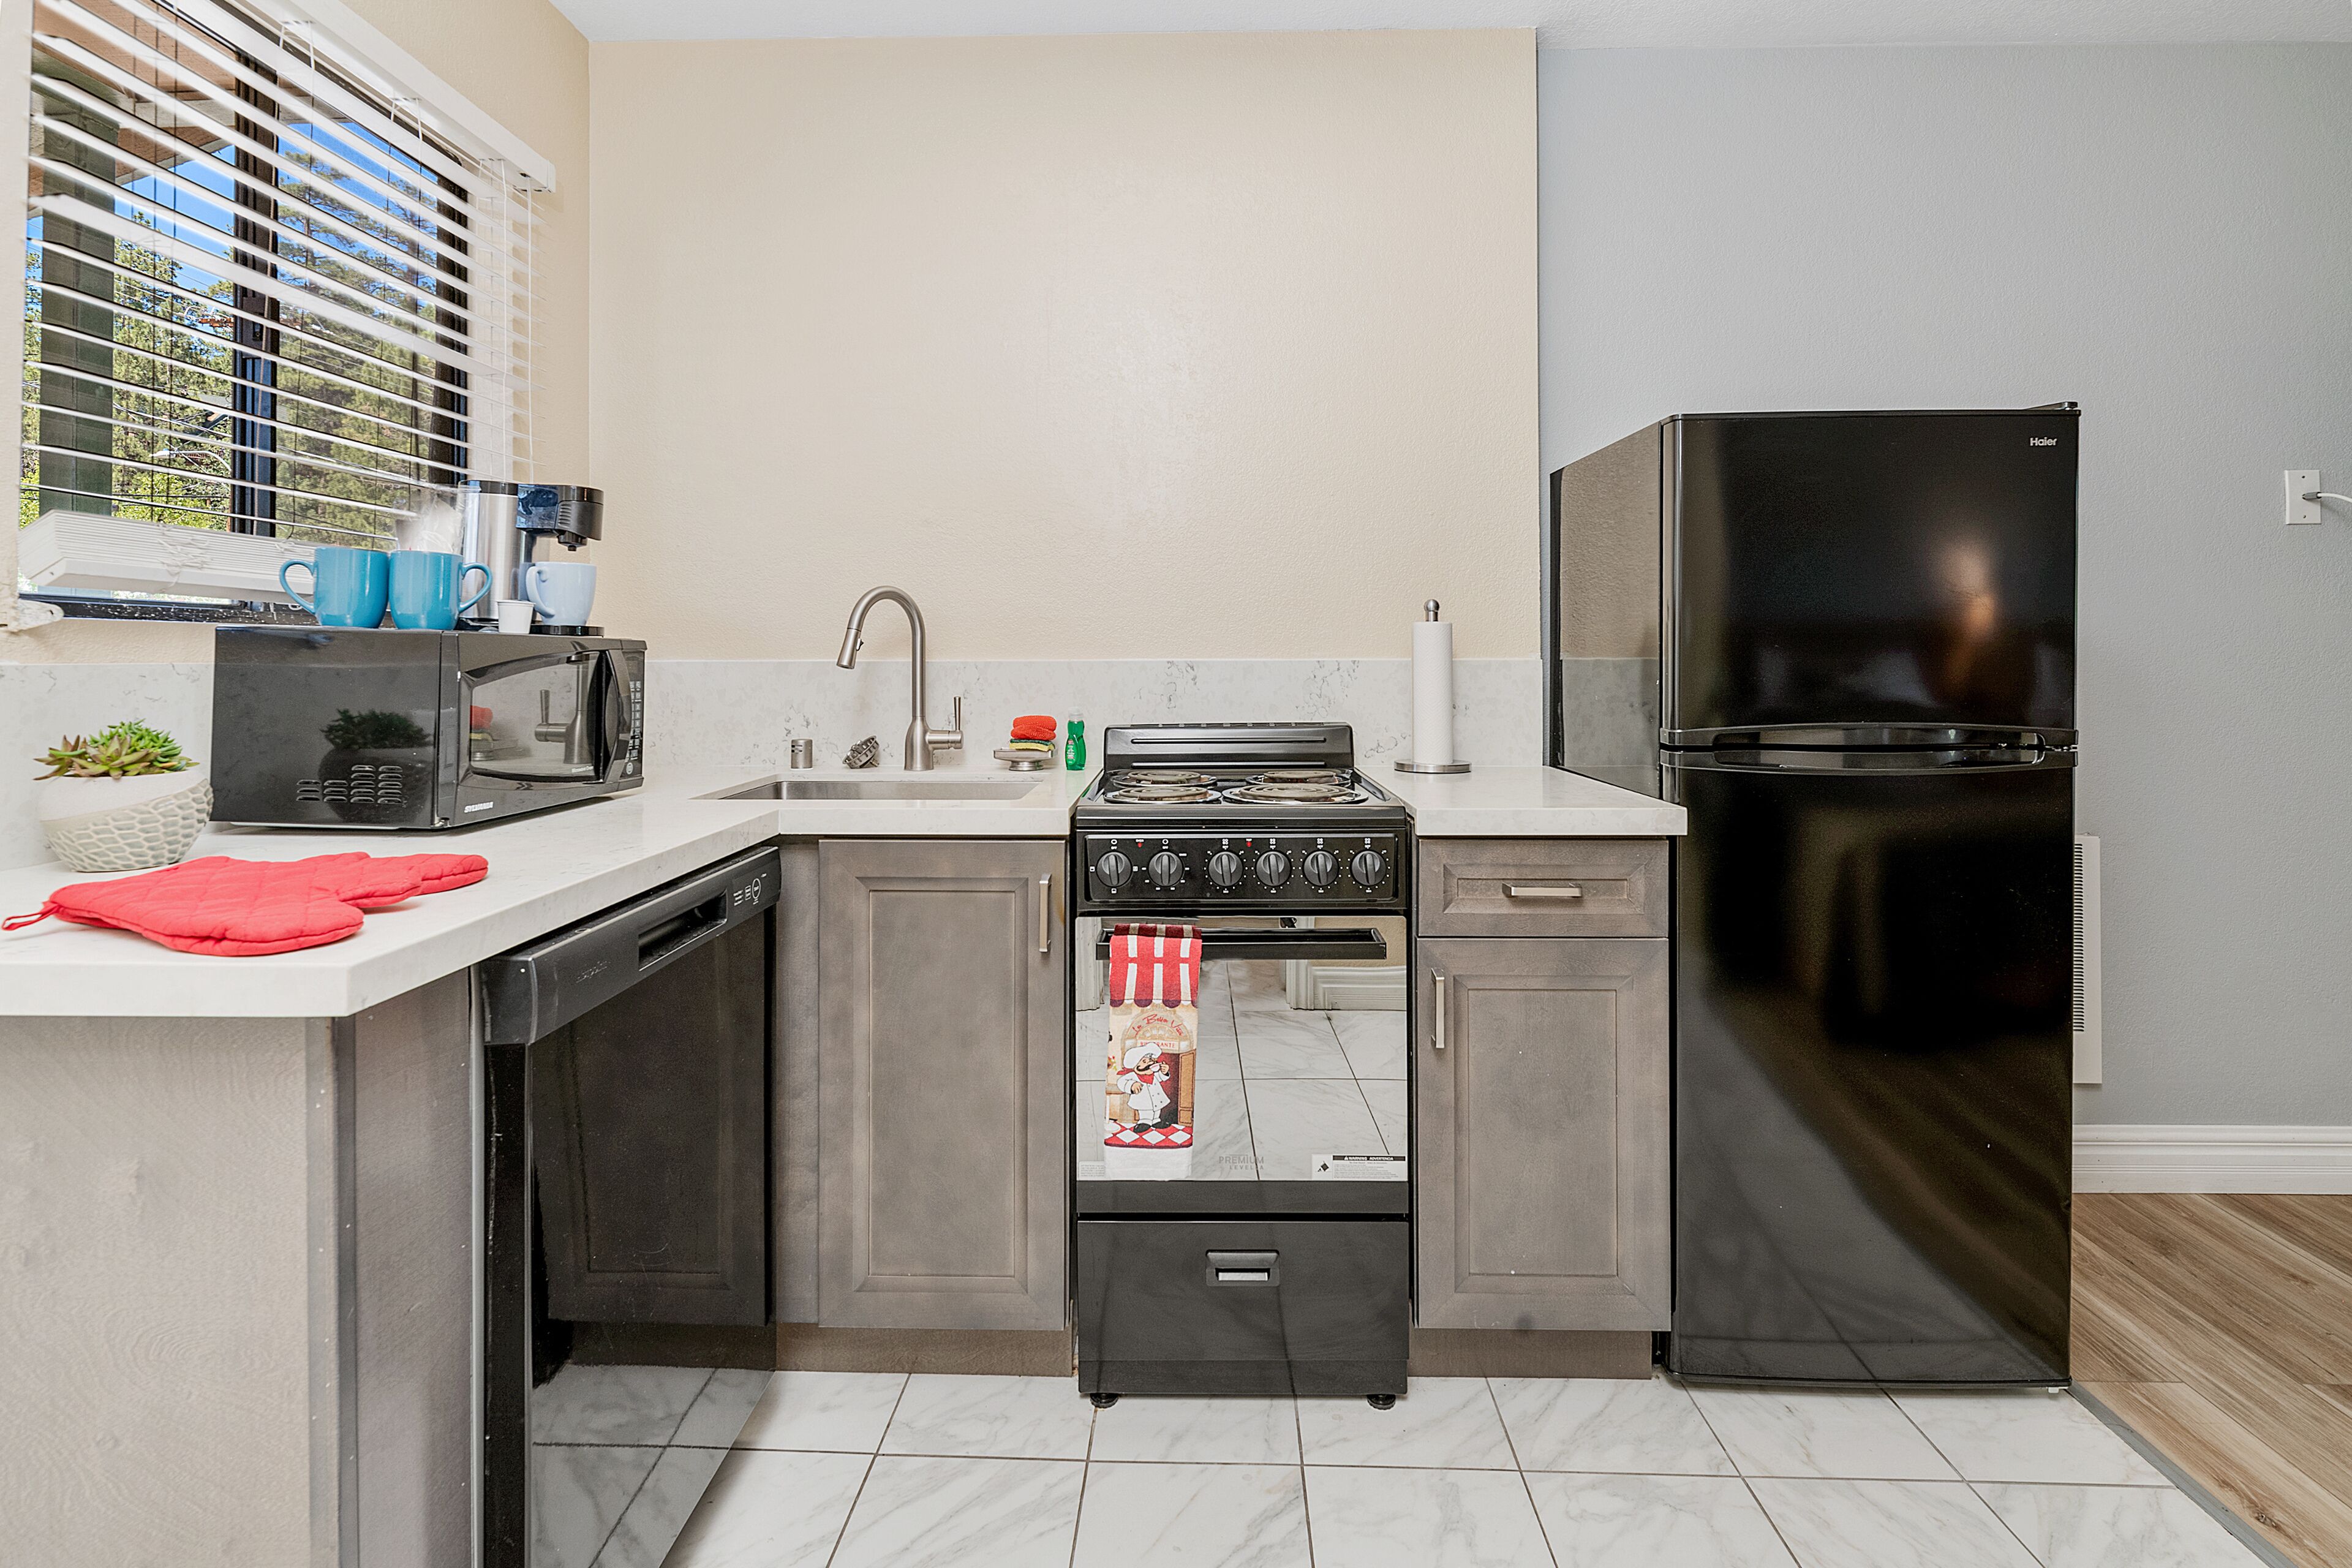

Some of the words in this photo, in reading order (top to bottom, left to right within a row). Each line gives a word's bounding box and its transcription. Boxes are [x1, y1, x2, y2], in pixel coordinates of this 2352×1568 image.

[2029, 437, 2057, 446] Haier
[464, 802, 494, 813] SYLVANIA
[1142, 1013, 1169, 1024] Bella
[1219, 1155, 1264, 1164] PREMIUM
